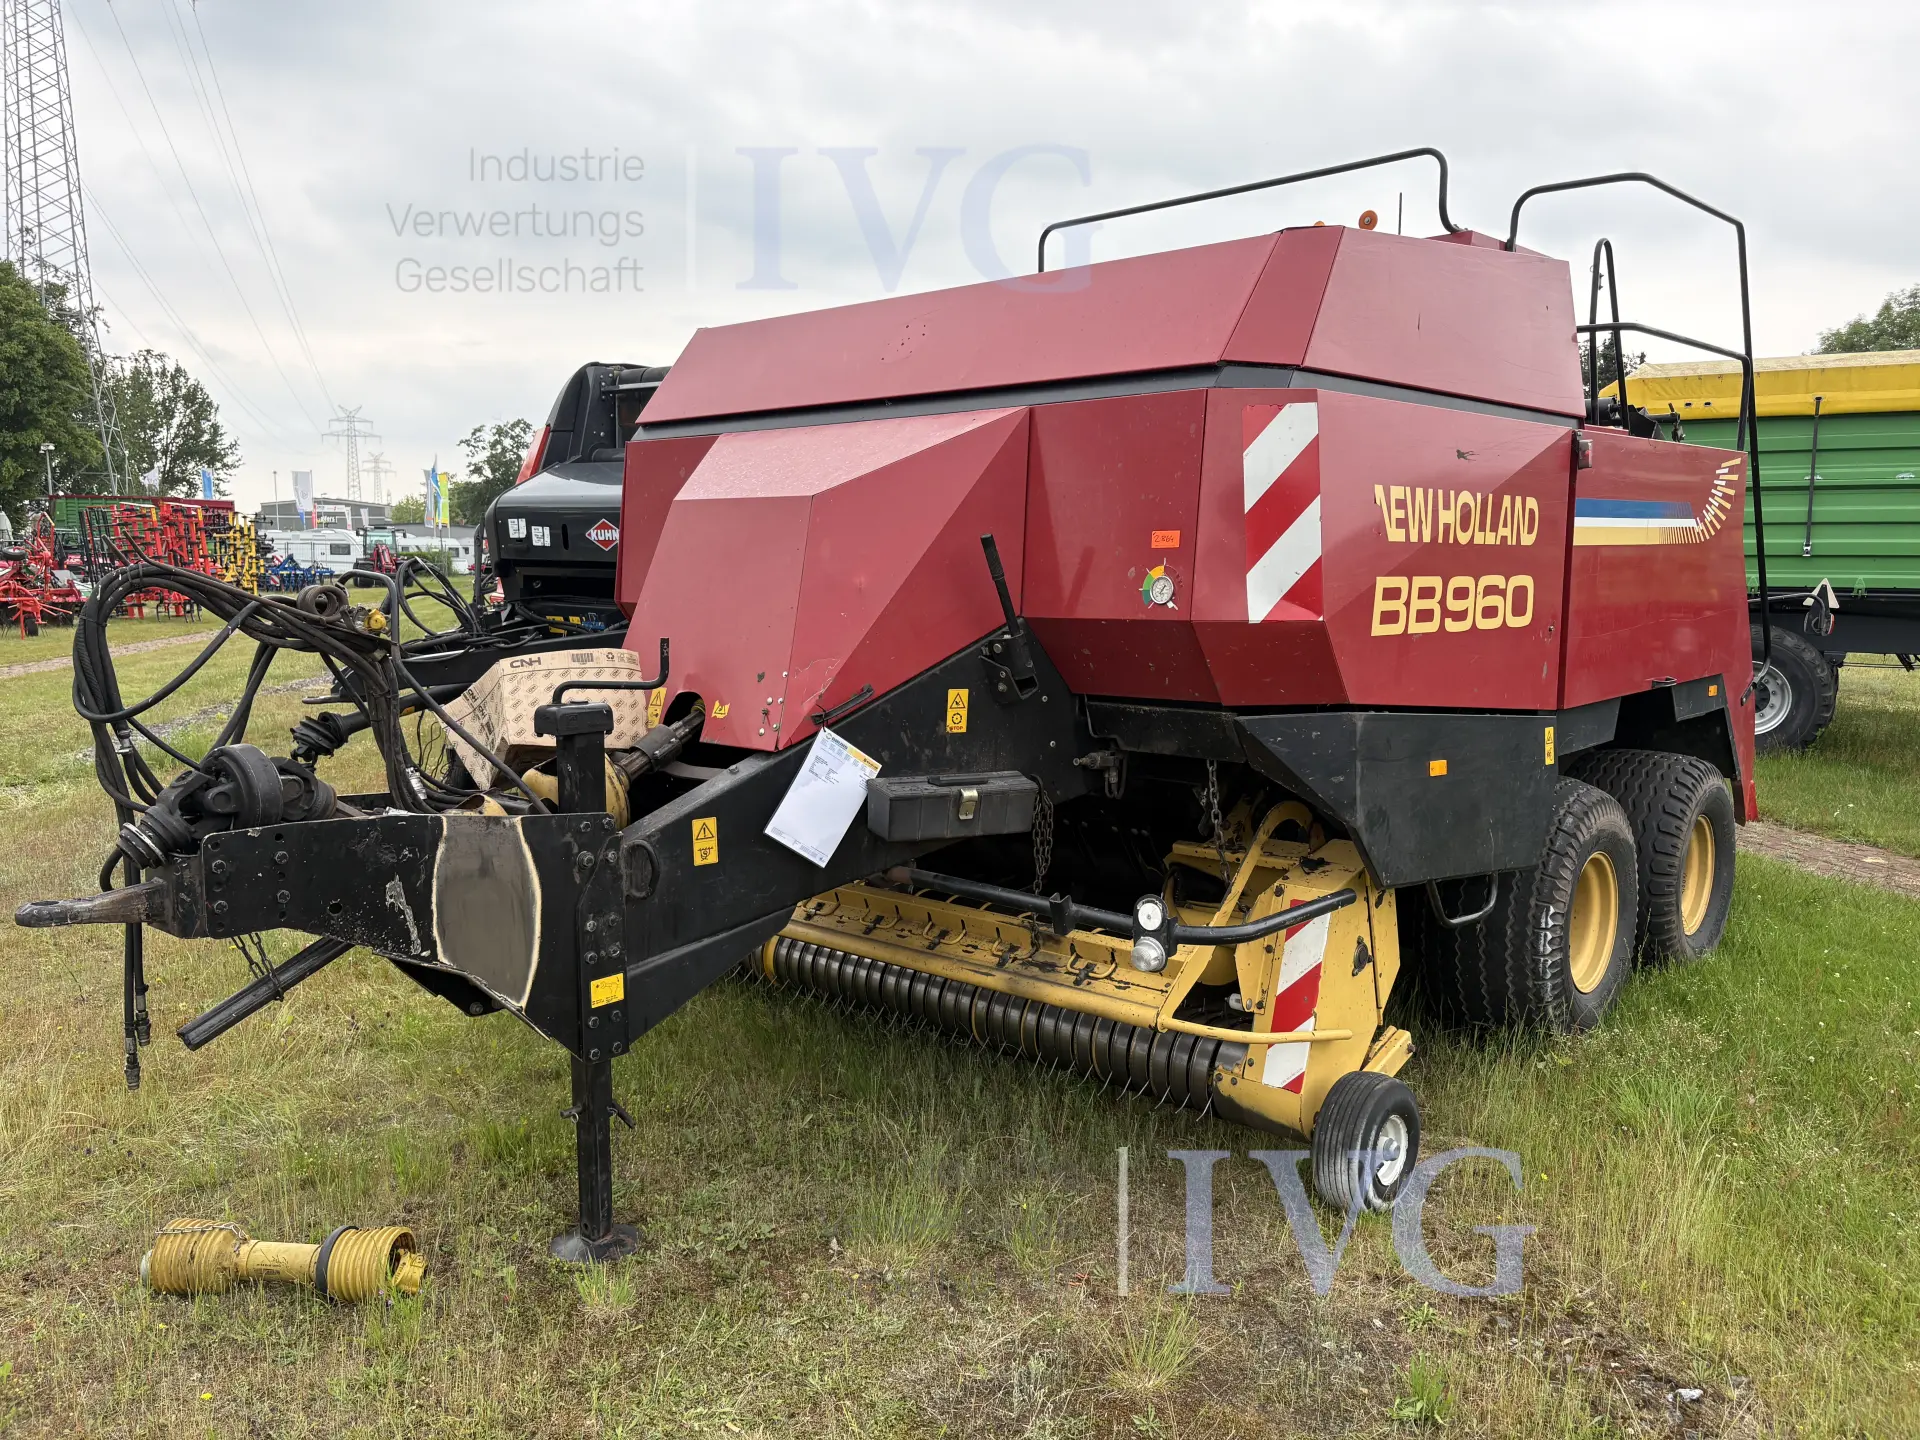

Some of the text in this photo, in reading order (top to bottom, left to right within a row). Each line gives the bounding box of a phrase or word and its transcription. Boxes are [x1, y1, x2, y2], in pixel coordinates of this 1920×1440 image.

[1374, 484, 1539, 546] NEW HOLLAND
[590, 529, 620, 541] KUHN
[1370, 574, 1535, 636] BB960
[510, 656, 541, 669] CNH
